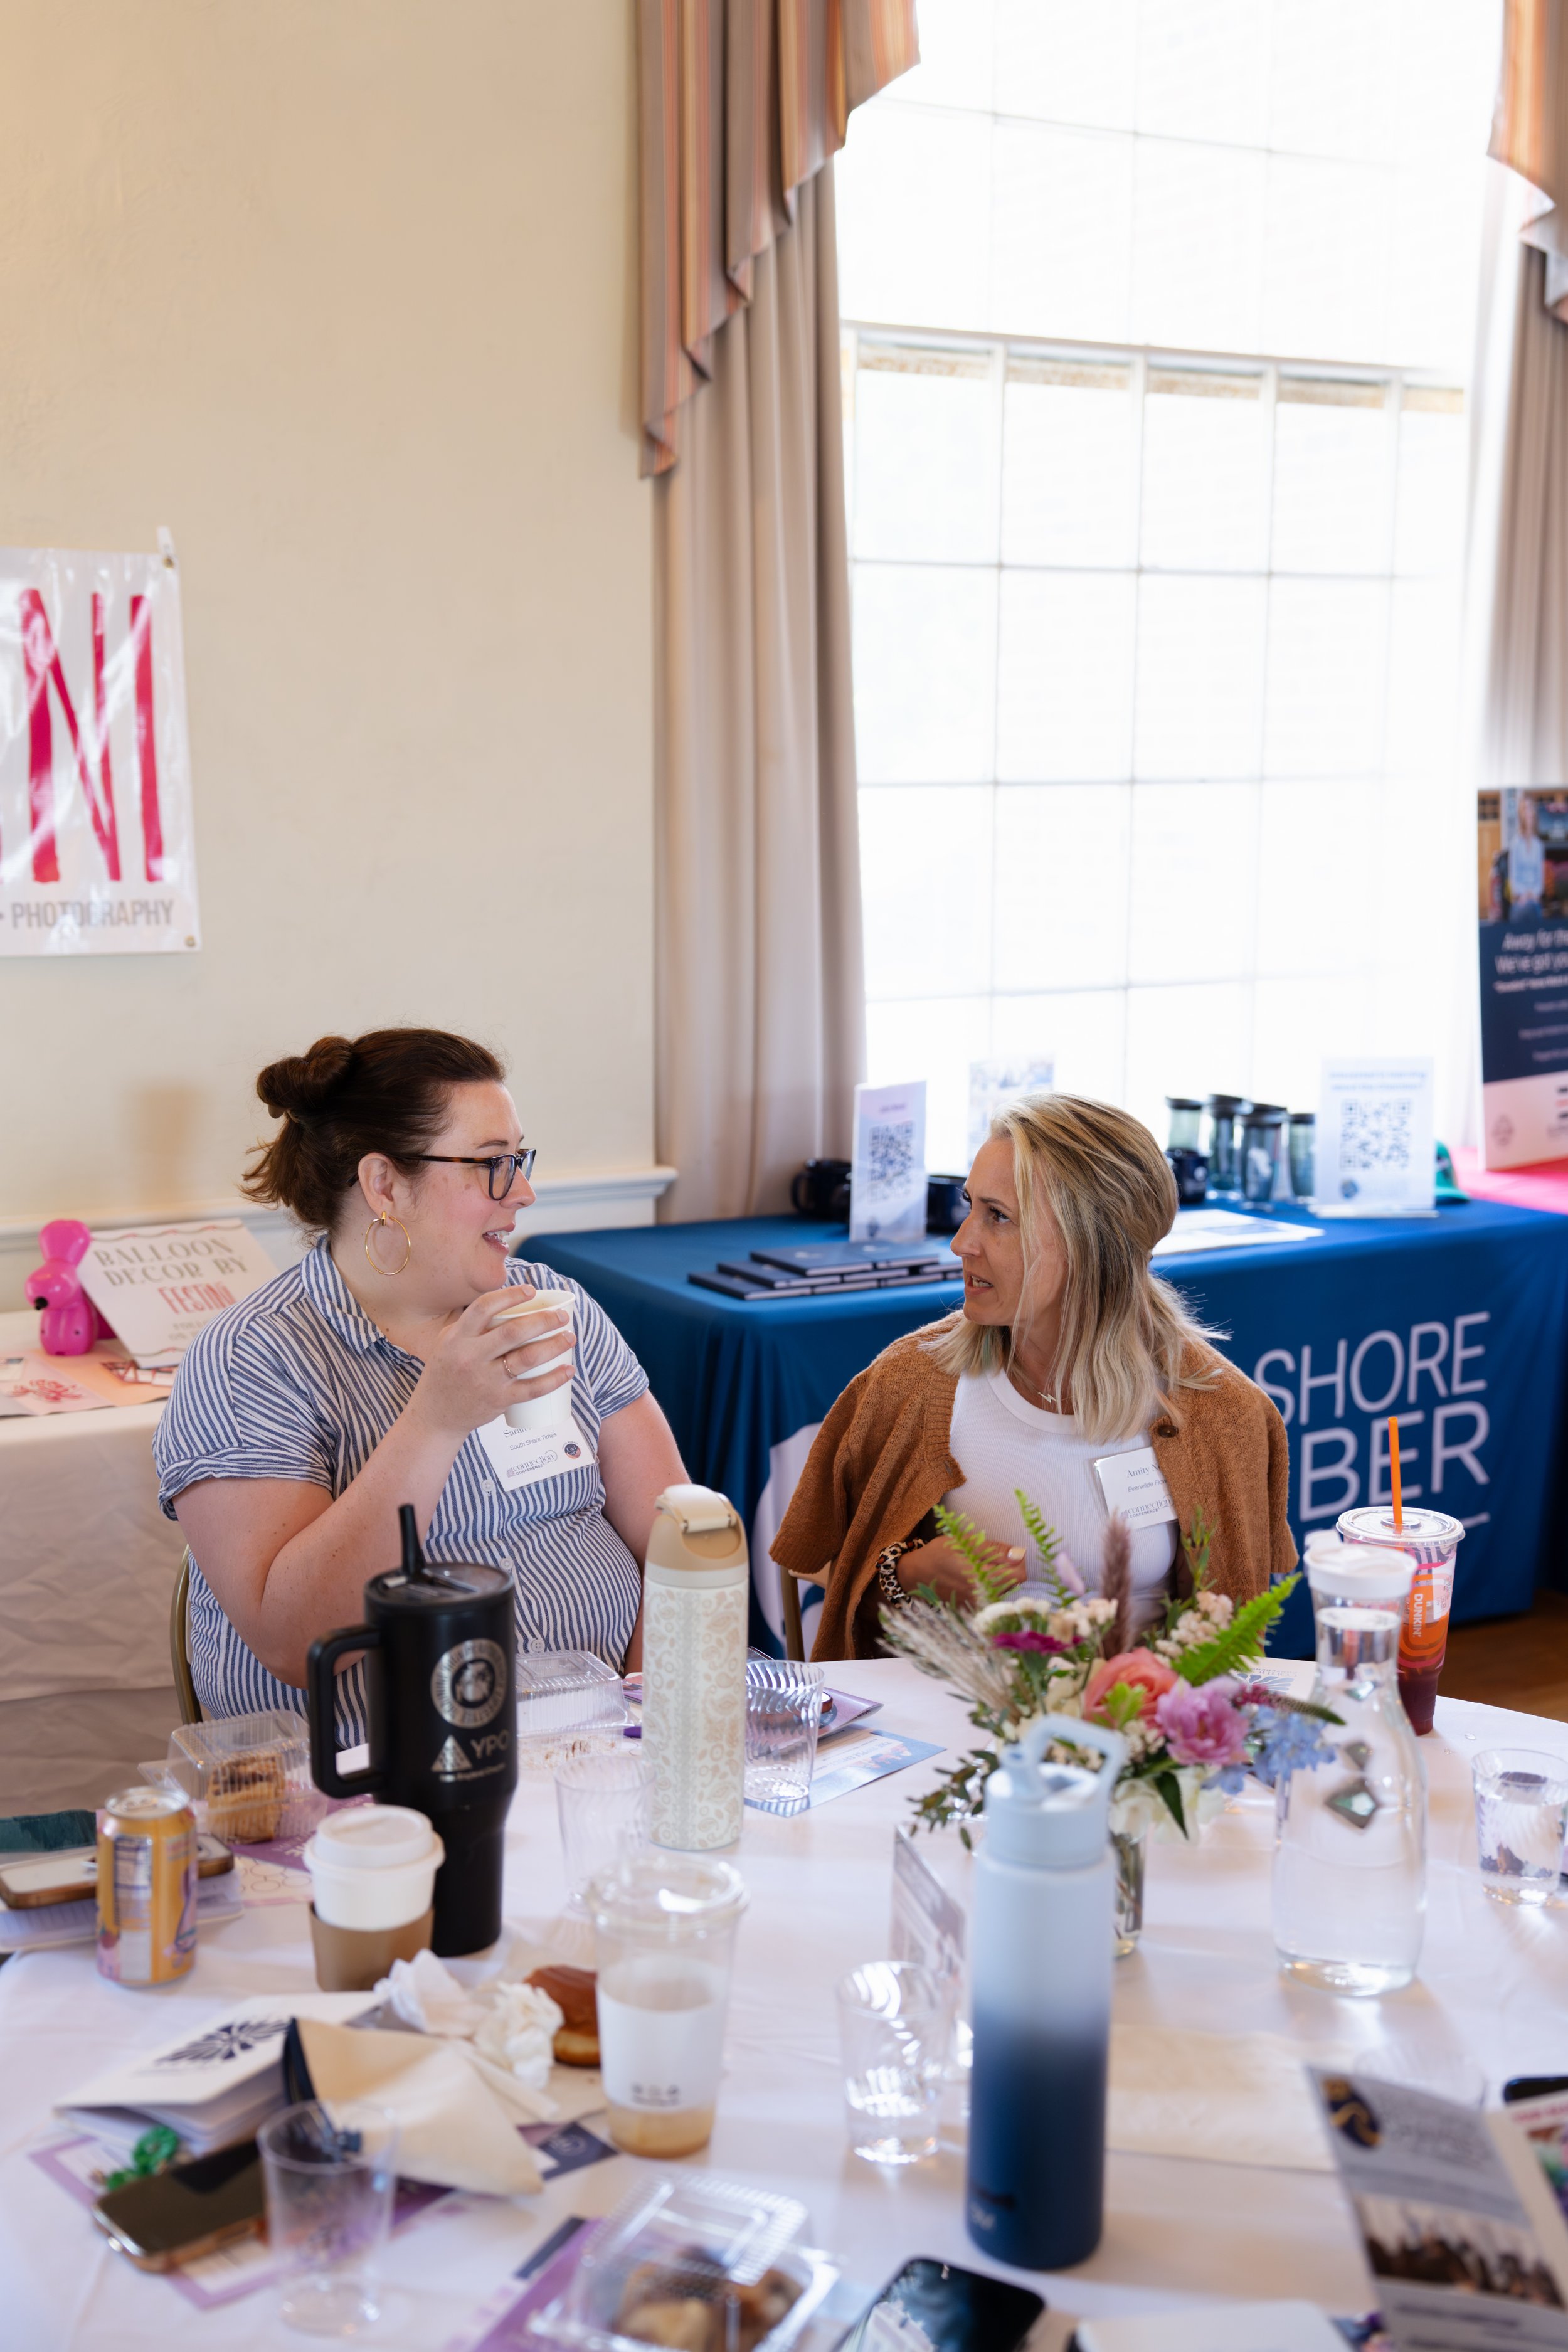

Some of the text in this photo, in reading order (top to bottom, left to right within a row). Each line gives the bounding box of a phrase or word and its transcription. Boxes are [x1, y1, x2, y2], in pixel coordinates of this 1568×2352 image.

[0, 588, 162, 883] NI
[93, 1238, 234, 1267] BALLOON
[103, 1256, 248, 1286] DECOR BY
[1255, 1311, 1490, 1426] SHORE
[510, 1433, 557, 1451] South Shore Times
[516, 1463, 543, 1475] CONFERENCE
[1127, 1467, 1150, 1478] Amity
[1128, 1481, 1153, 1493] Everwilde
[1130, 1508, 1158, 1518] CONFERENCE
